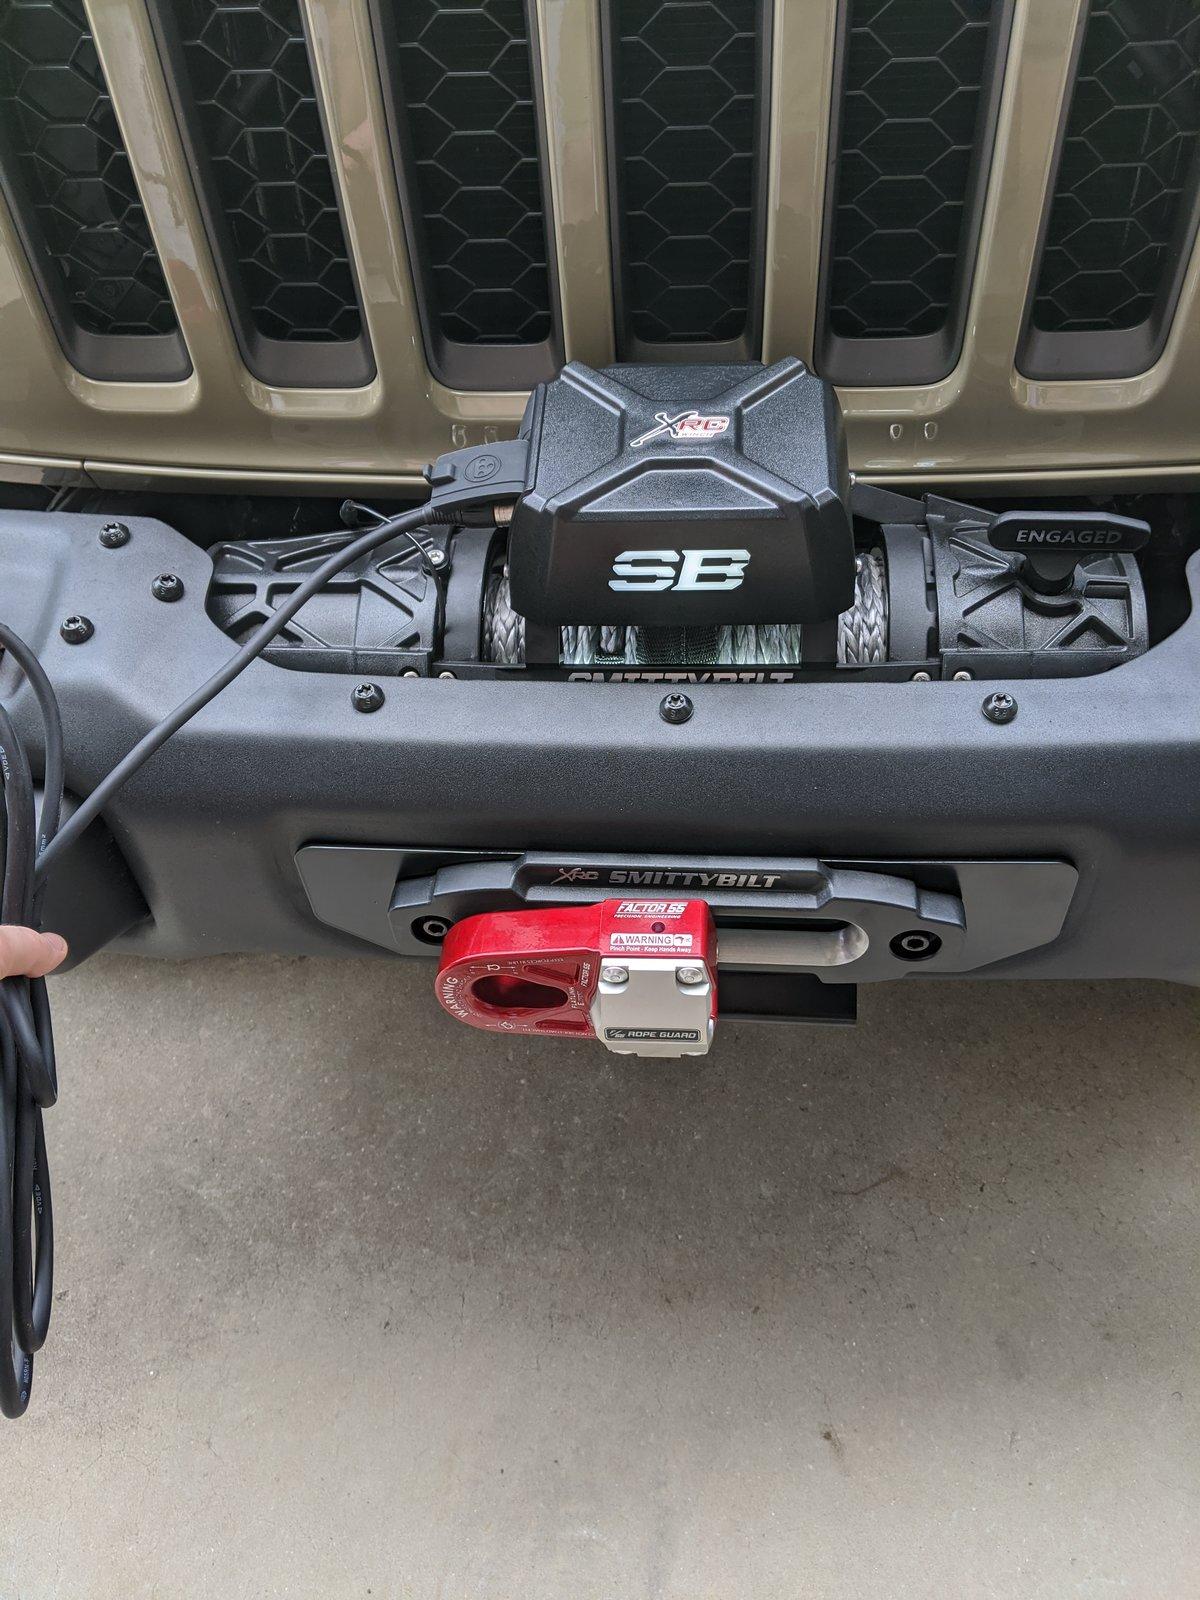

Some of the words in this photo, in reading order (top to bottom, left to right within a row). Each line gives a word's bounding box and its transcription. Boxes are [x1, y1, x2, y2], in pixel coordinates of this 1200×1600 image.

[630, 411, 729, 446] XRC
[1016, 529, 1121, 544] ENGAGED
[608, 549, 751, 591] SB
[550, 867, 600, 885] XRC
[608, 870, 781, 888] SMITTYBILT
[616, 903, 667, 913] FACTOR
[667, 903, 687, 913] 55
[625, 936, 672, 944] WARNING
[443, 976, 469, 1018] WARNING
[659, 1031, 697, 1039] GUARD
